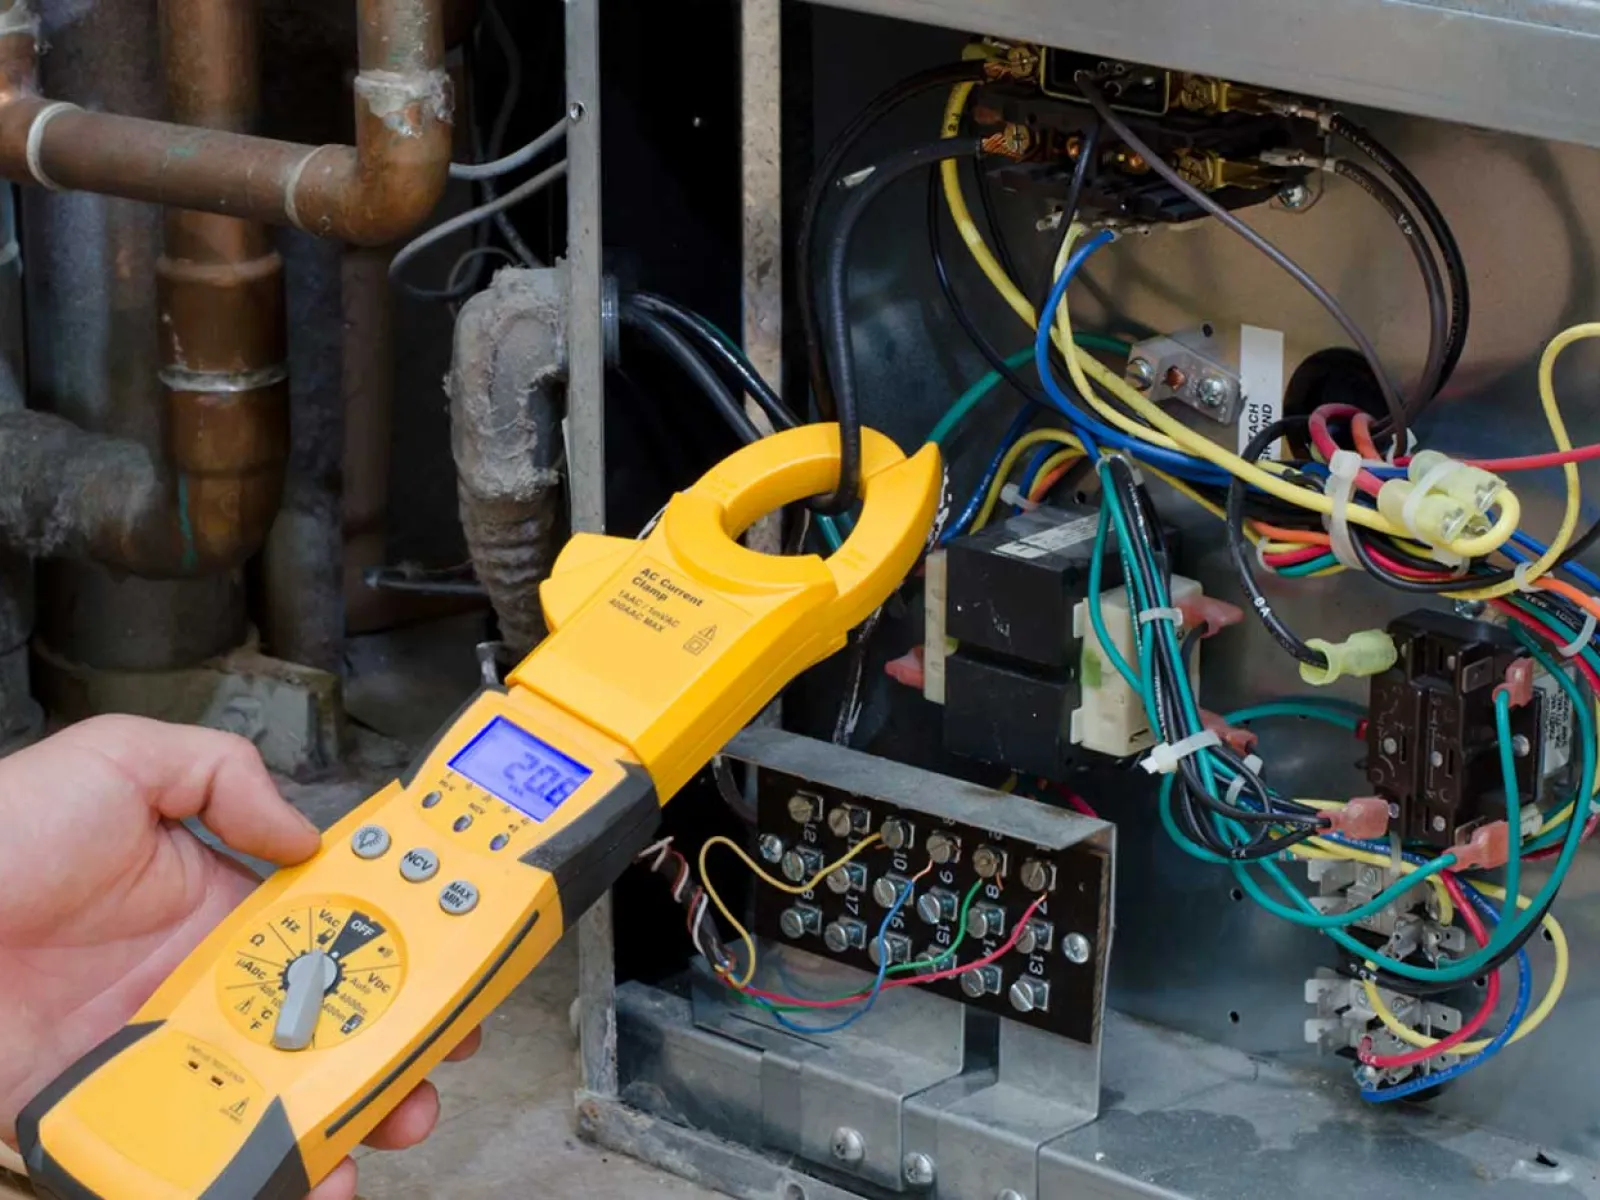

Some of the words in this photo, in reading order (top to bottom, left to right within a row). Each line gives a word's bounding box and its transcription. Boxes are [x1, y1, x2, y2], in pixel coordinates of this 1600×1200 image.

[631, 576, 669, 602] Clamp
[640, 567, 660, 581] AC
[660, 578, 704, 607] Current
[804, 823, 817, 843] 12
[403, 850, 433, 871] NCV
[893, 851, 908, 871] 10
[939, 870, 954, 883] 9
[442, 891, 464, 908] MIN
[448, 882, 474, 900] MAX
[985, 884, 999, 899] 8
[845, 893, 859, 916] 17
[280, 916, 301, 933] Hz
[351, 919, 375, 937] OFF
[891, 911, 905, 928] 16
[249, 933, 266, 947] Ω
[936, 924, 950, 945] 15
[1029, 953, 1044, 976] 13
[350, 976, 372, 995] Auto
